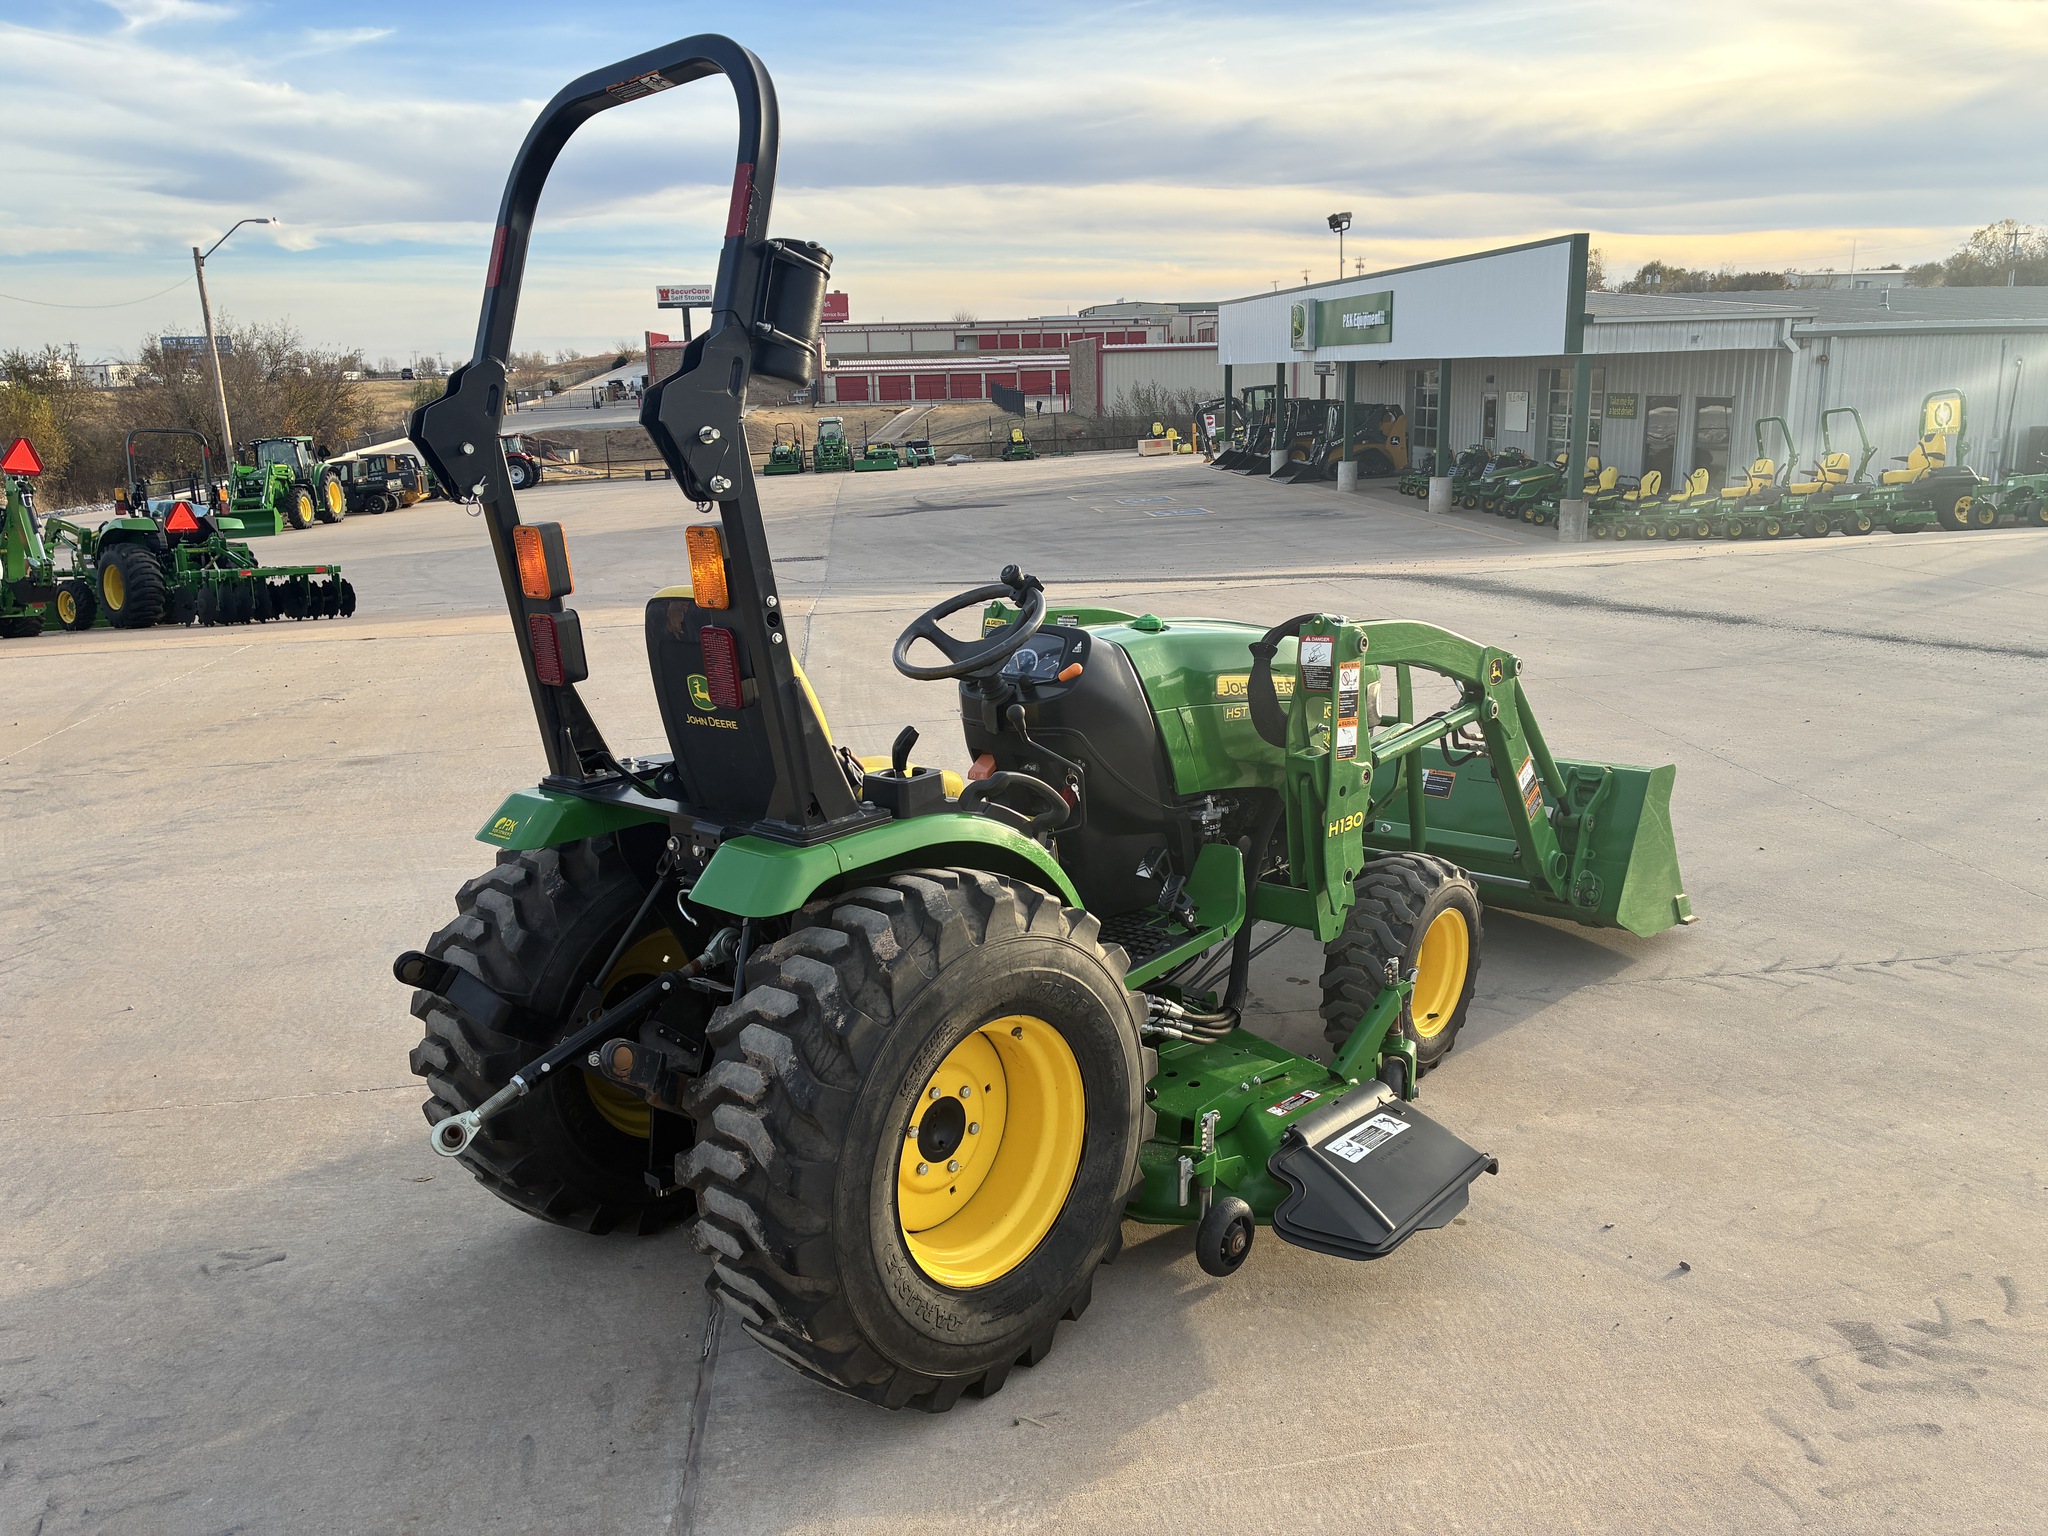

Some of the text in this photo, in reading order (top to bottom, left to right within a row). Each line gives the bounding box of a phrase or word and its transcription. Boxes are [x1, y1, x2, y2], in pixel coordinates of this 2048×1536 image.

[1342, 310, 1386, 330] P&K Equipment
[1330, 437, 1344, 447] DEER
[1223, 680, 1248, 695] JOH
[1225, 706, 1249, 719] HST
[686, 713, 739, 730] JOHN DEERE
[1328, 811, 1364, 838] H130
